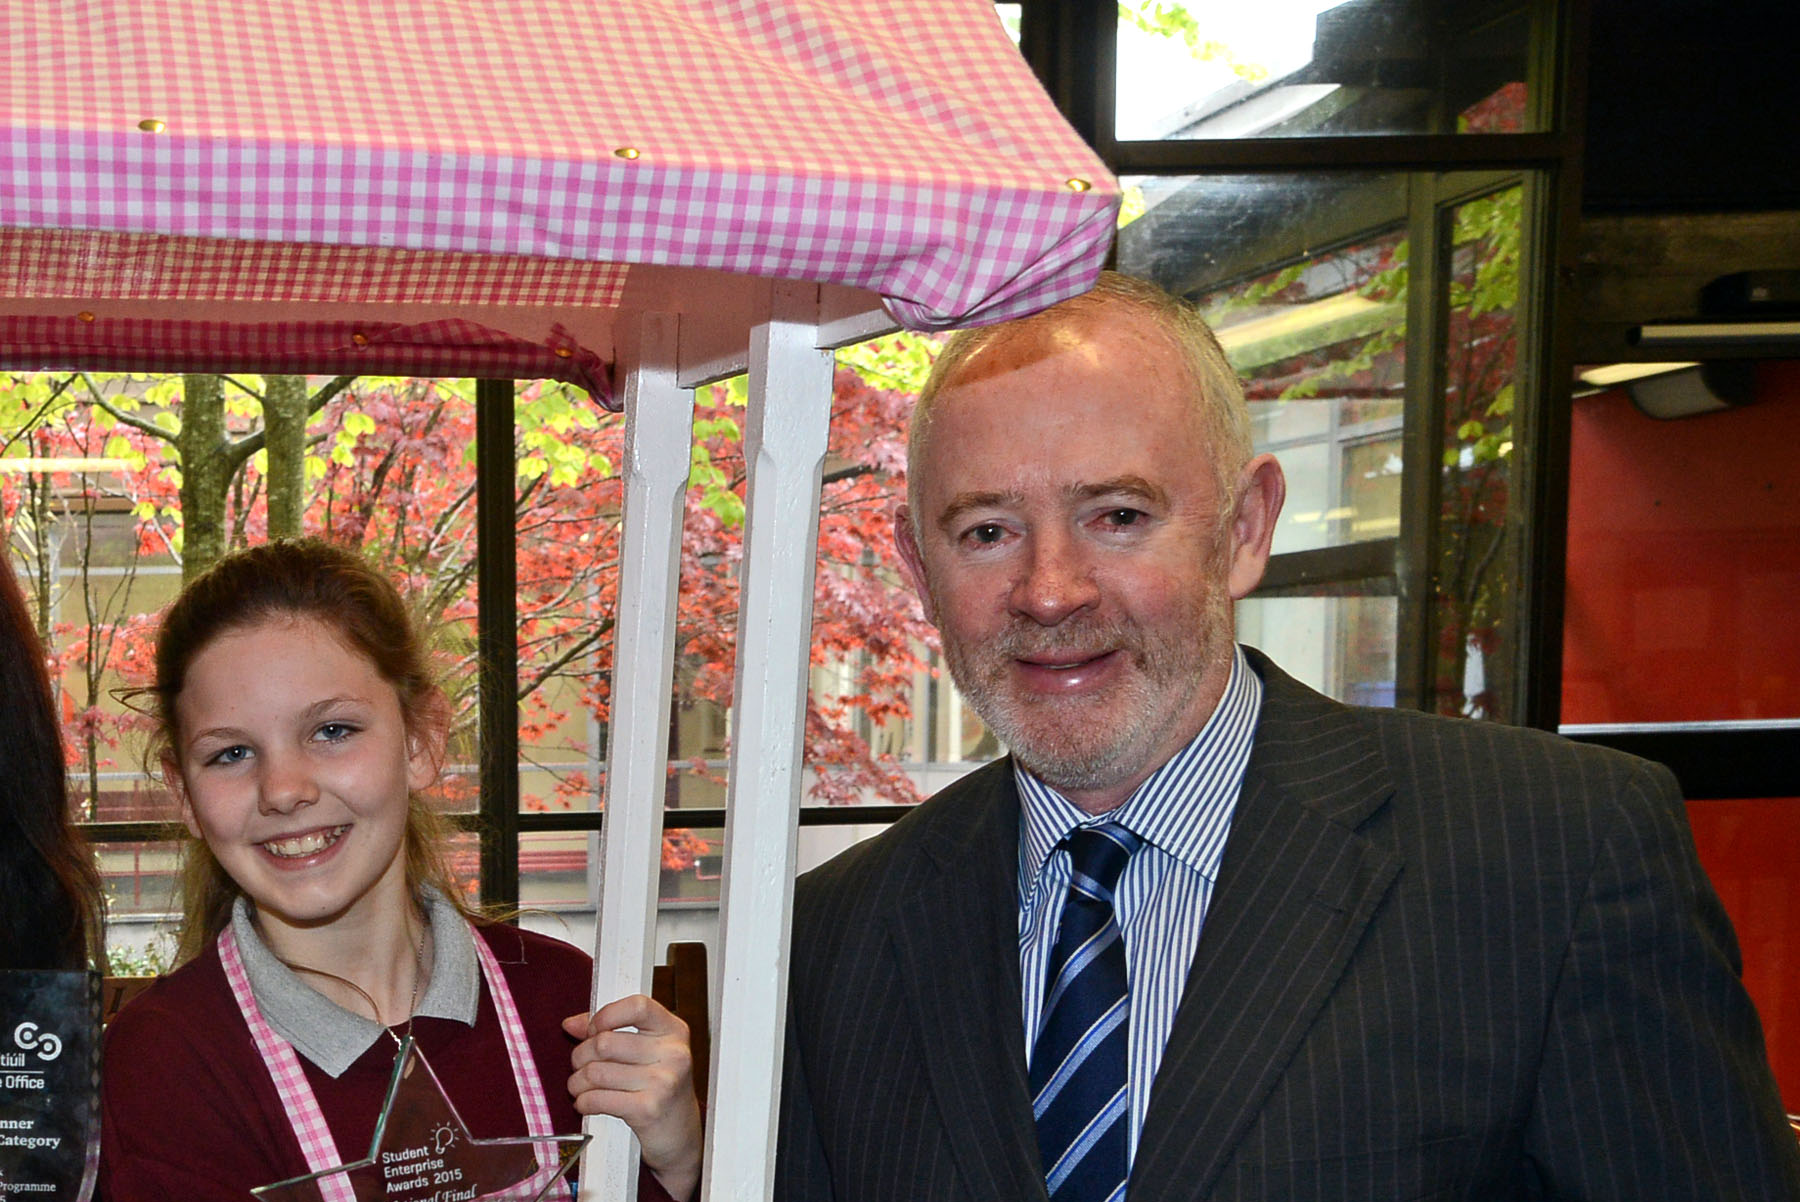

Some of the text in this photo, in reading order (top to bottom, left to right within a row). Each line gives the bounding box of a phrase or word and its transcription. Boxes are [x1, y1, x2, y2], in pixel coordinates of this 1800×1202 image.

[5, 1075, 45, 1089] Office
[382, 1146, 430, 1164] Student
[384, 1158, 444, 1178] Enterprise
[386, 1168, 463, 1194] Awards 2015
